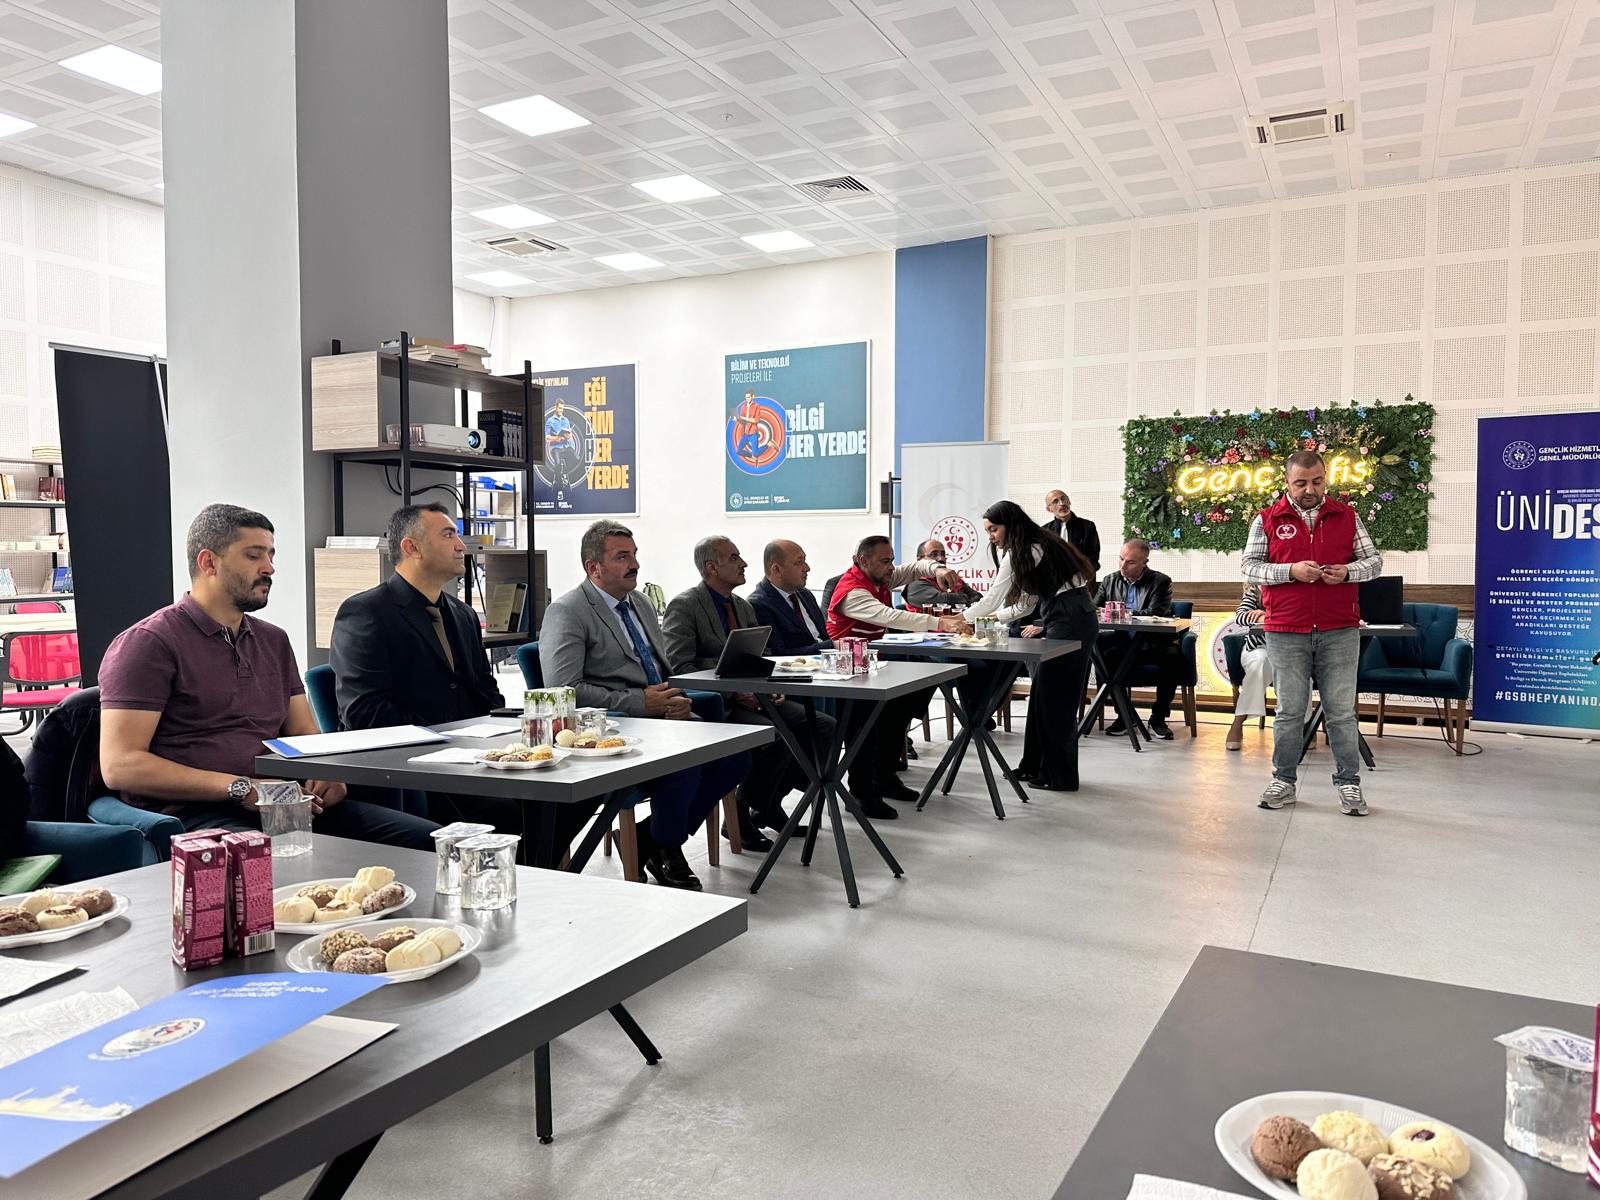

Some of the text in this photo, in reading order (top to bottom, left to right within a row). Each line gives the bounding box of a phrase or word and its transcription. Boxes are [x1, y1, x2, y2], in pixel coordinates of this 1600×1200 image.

[731, 354, 790, 371] BİLİM VE TEKNOLOJİ
[732, 370, 773, 384] PROJELERİ İLE
[584, 376, 606, 406] EĞİ
[584, 406, 614, 435] TİM
[785, 402, 825, 432] BİLGİ
[585, 438, 613, 463] HER
[785, 429, 866, 459] HER YERDE
[1538, 445, 1600, 454] GENÇLİK HİZMETL
[585, 464, 629, 490] YERDE
[1328, 455, 1368, 484] fis
[1495, 690, 1600, 707] #GSBHEPYANIND
